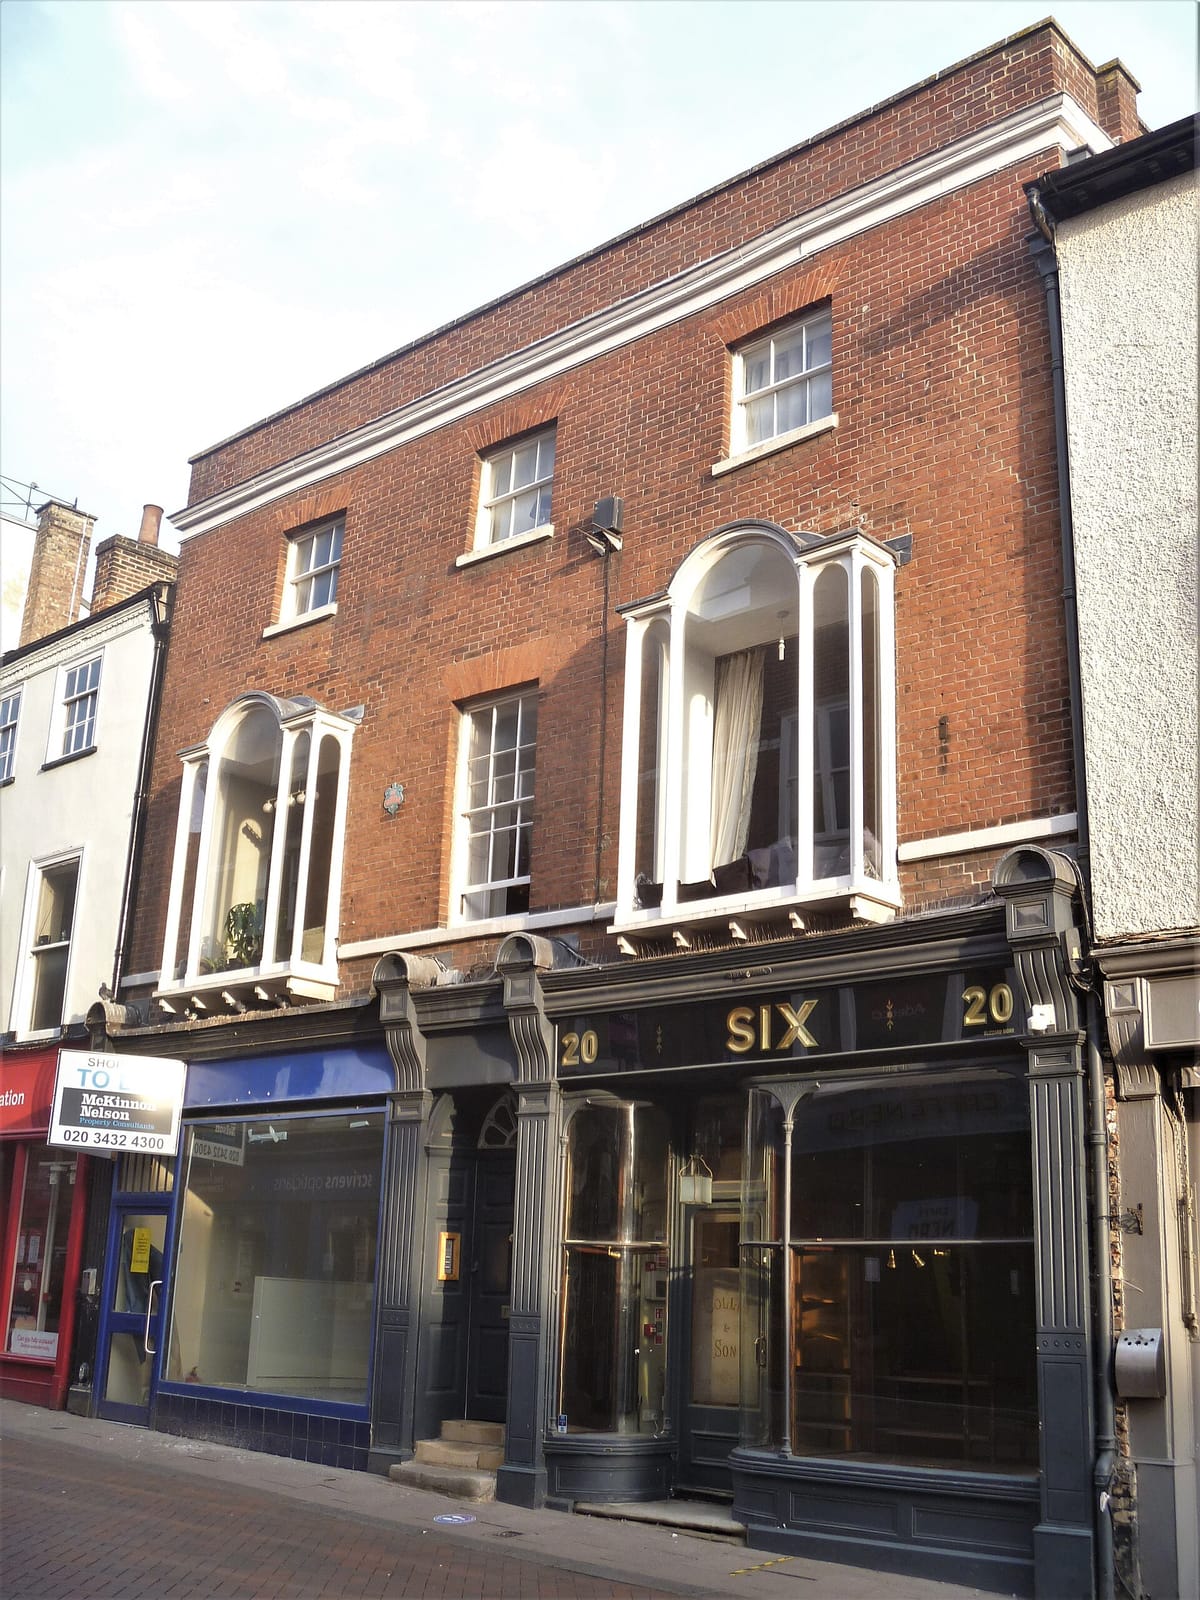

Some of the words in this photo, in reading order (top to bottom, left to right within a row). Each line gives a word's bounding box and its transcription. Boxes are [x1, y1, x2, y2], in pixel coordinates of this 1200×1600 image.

[962, 983, 1014, 1027] 20
[725, 999, 819, 1054] SIX
[561, 1029, 599, 1067] 20
[77, 1068, 110, 1089] TO
[79, 1117, 112, 1128] Property
[112, 1119, 155, 1130] Consultants
[80, 1105, 130, 1121] Nelson
[63, 1129, 88, 1143] 020
[93, 1132, 127, 1146] 3432
[131, 1135, 164, 1150] 4300
